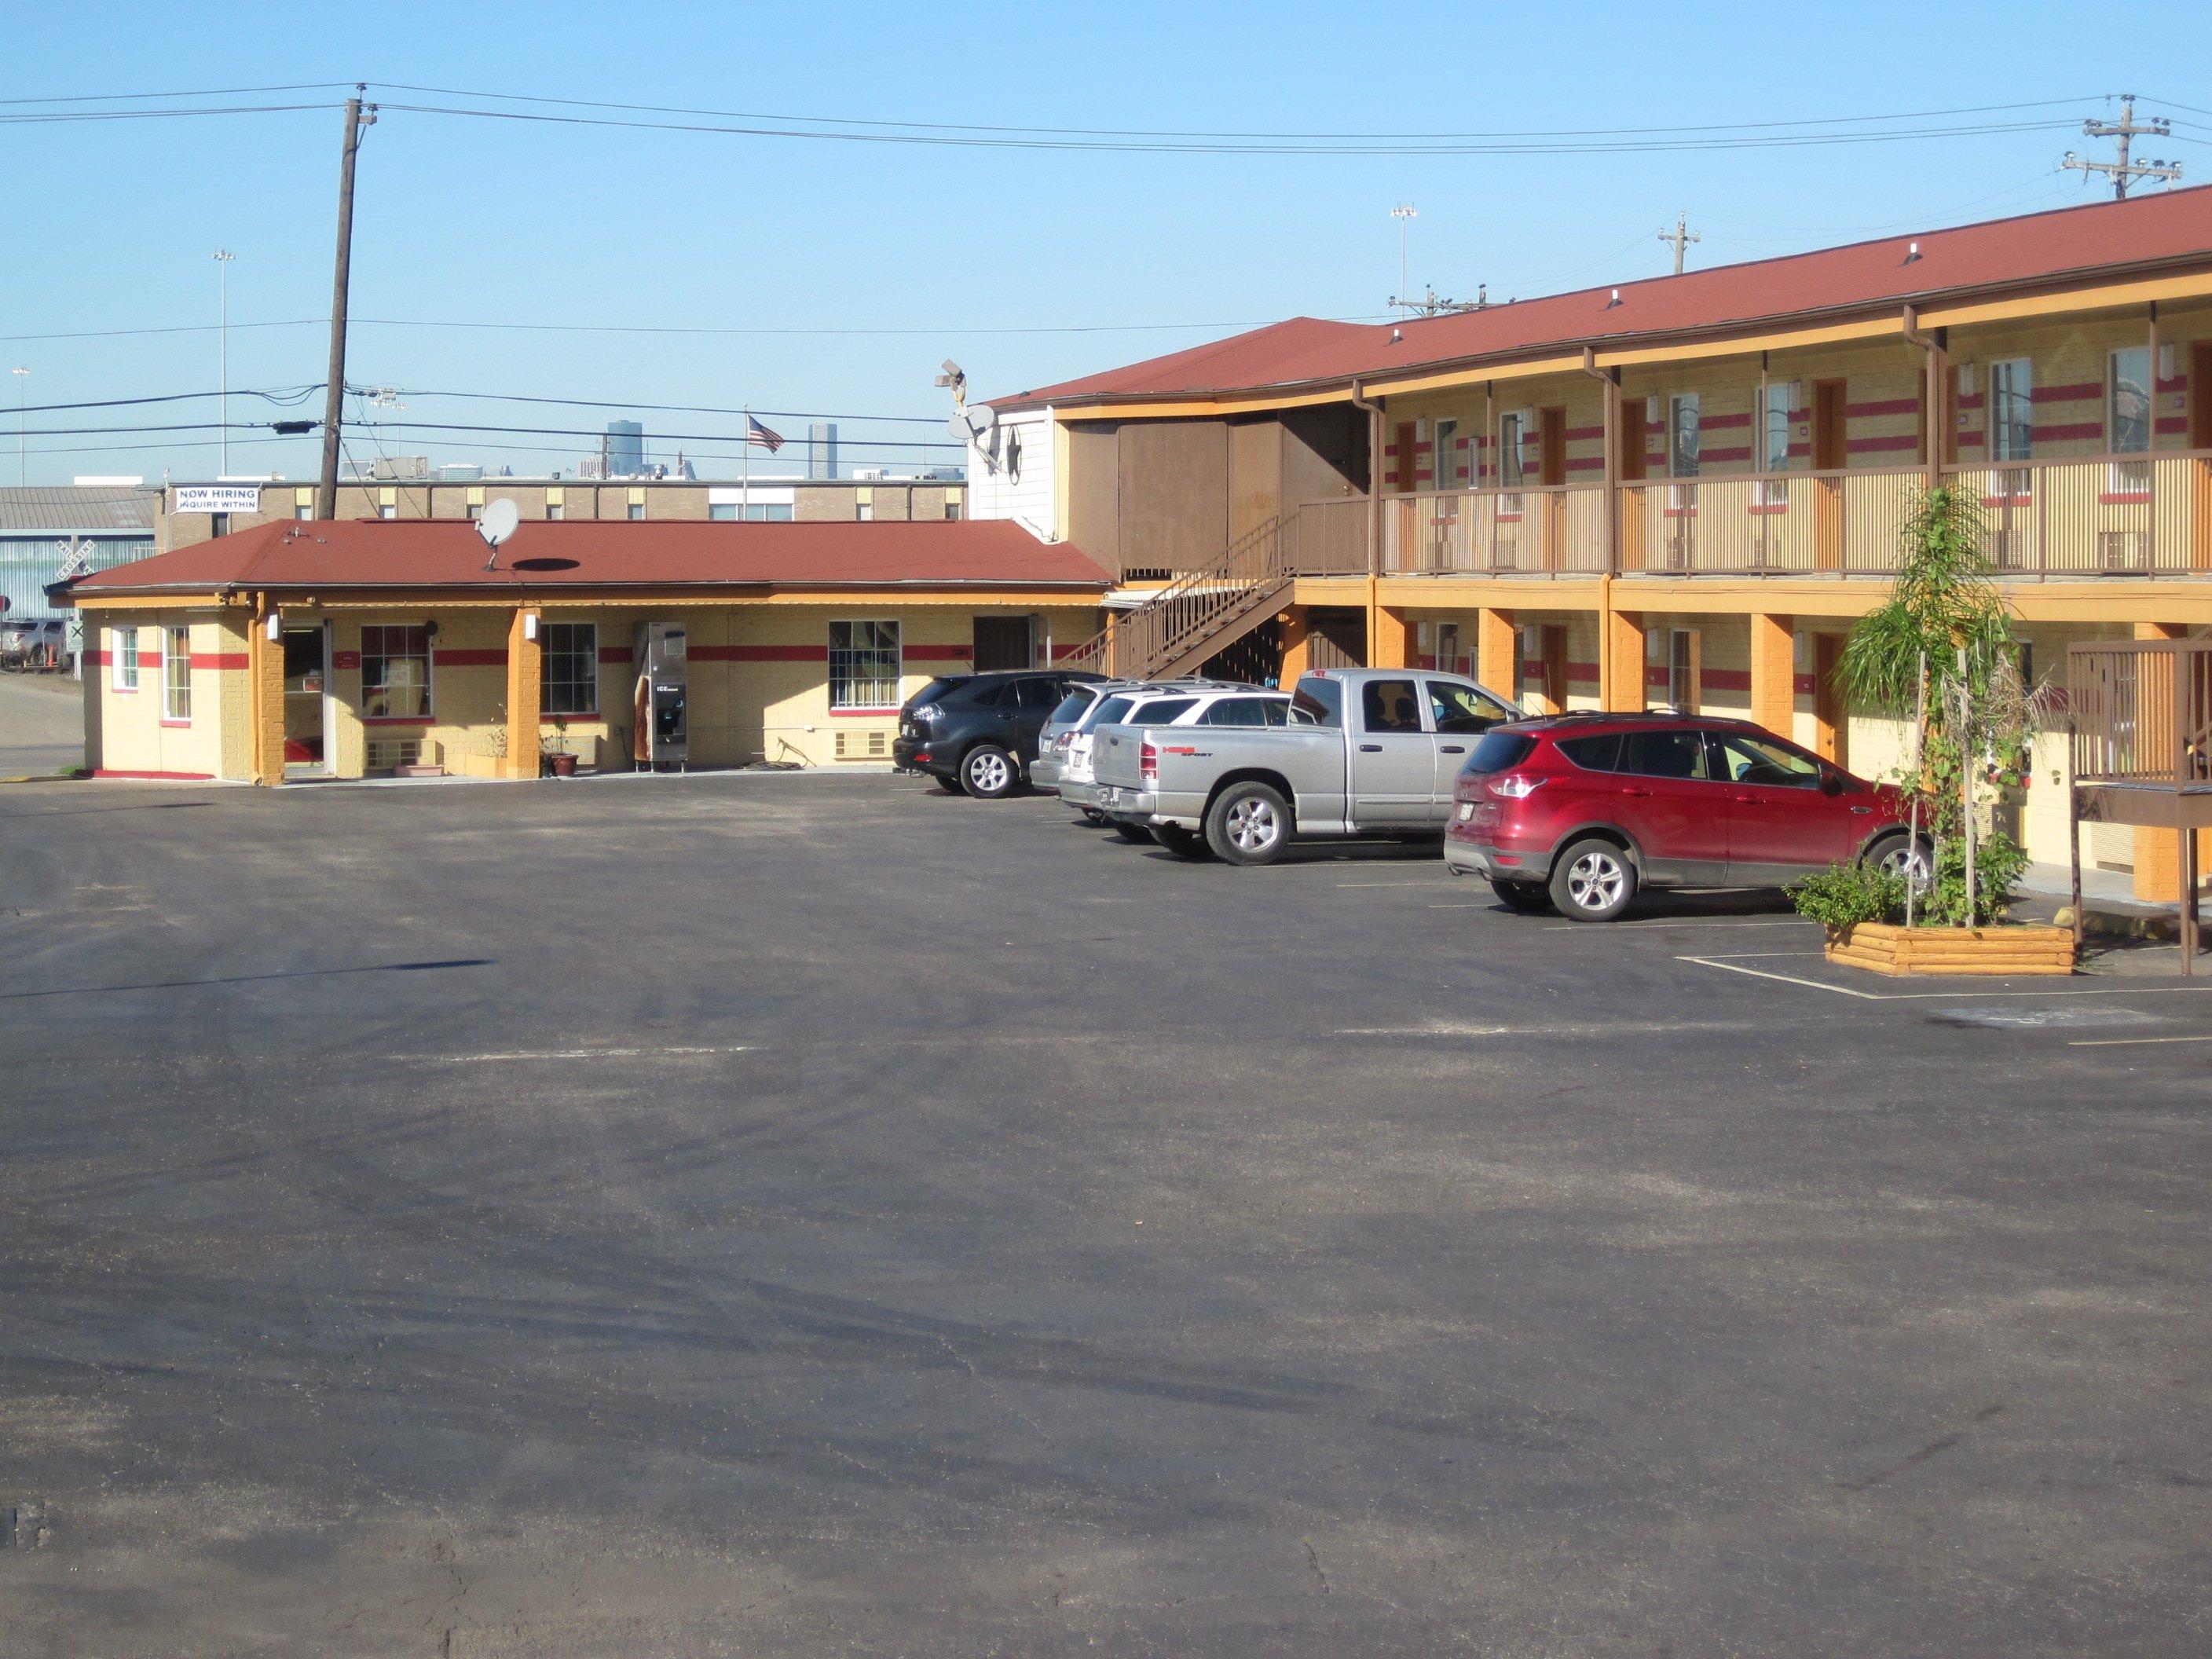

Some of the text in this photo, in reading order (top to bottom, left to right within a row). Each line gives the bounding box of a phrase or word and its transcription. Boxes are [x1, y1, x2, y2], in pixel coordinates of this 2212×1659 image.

[179, 489, 255, 499] NOW HIRING
[56, 542, 72, 558] RAIL
[57, 541, 93, 580] CROSSING
